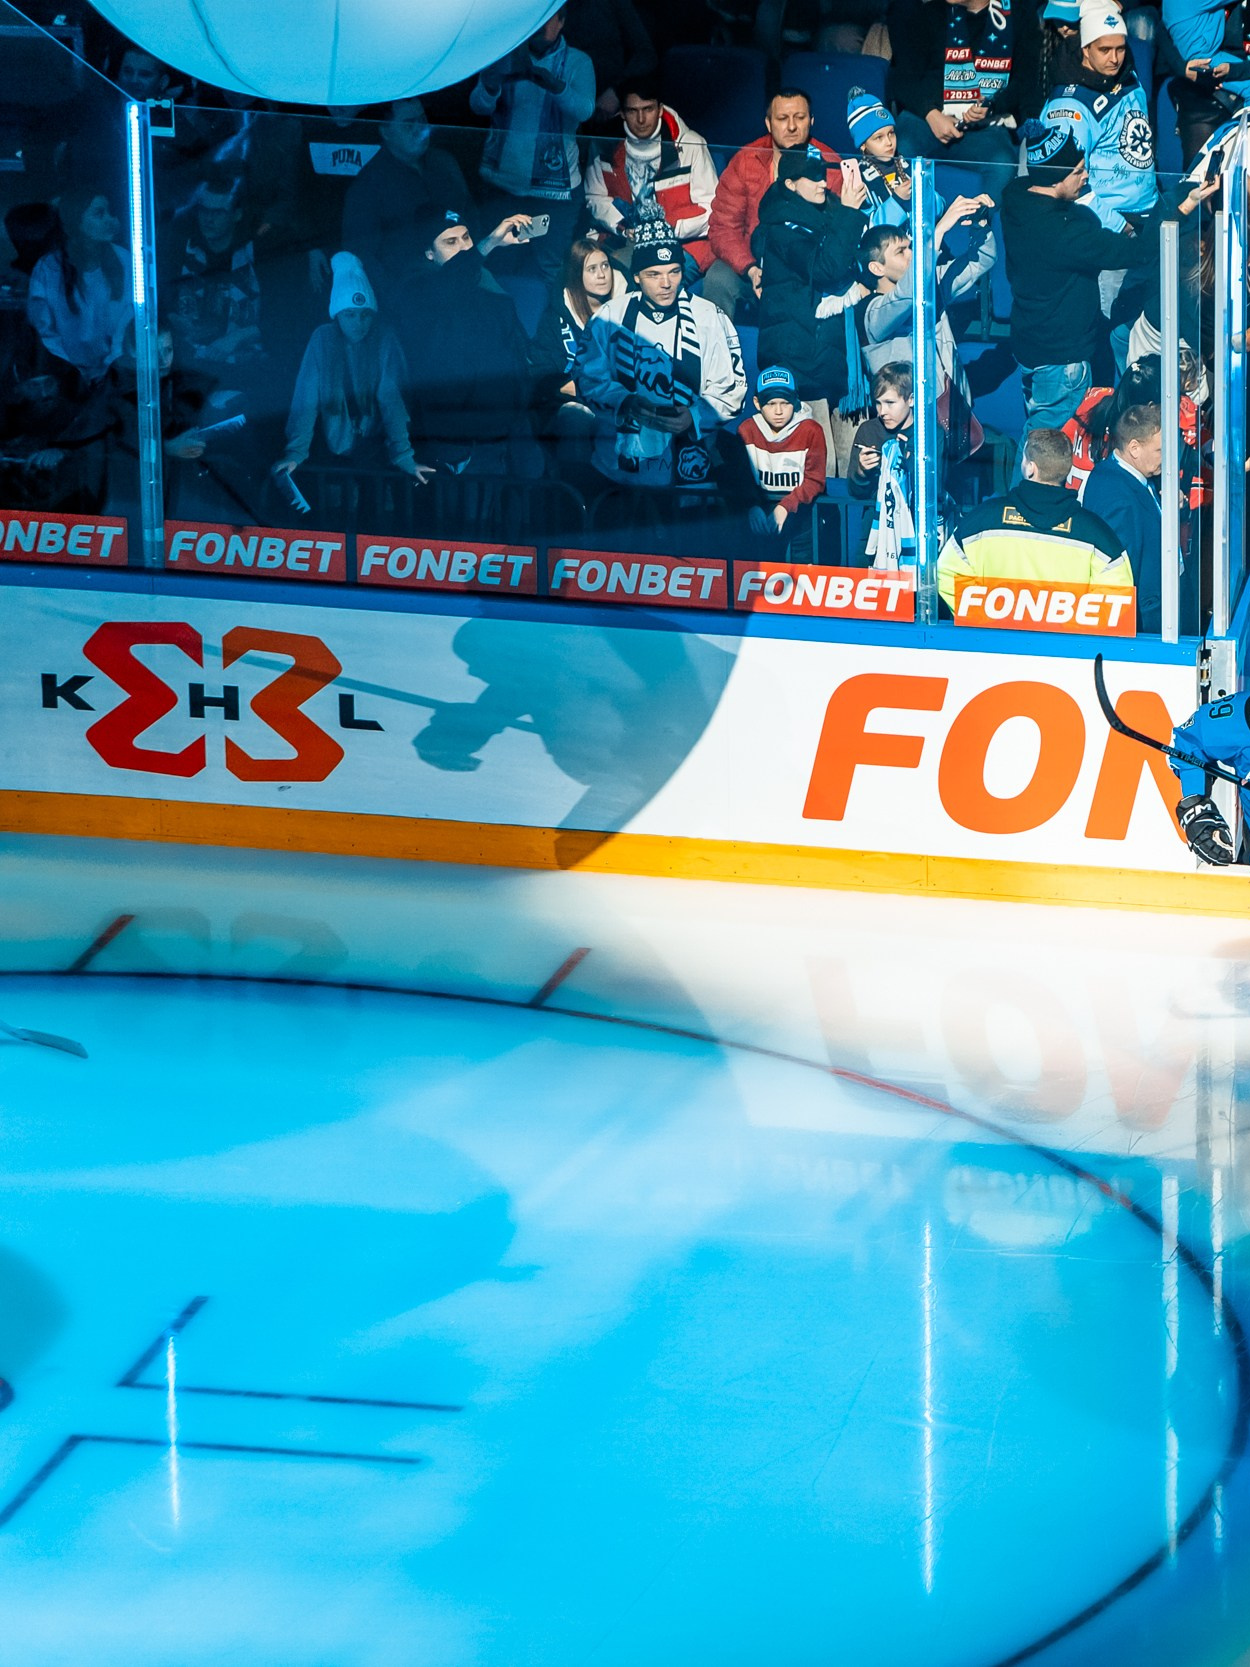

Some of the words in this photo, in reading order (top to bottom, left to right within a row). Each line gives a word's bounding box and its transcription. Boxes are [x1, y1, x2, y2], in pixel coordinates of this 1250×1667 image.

[975, 58, 1011, 69] FONBET
[950, 91, 974, 99] 2023
[331, 148, 363, 168] PUMA
[0, 519, 124, 557] NBET
[168, 530, 342, 573] FONBET
[360, 545, 533, 587] FONBET
[551, 558, 723, 599] FONBET
[737, 571, 909, 612] FONBET
[957, 586, 1132, 627] FONBET
